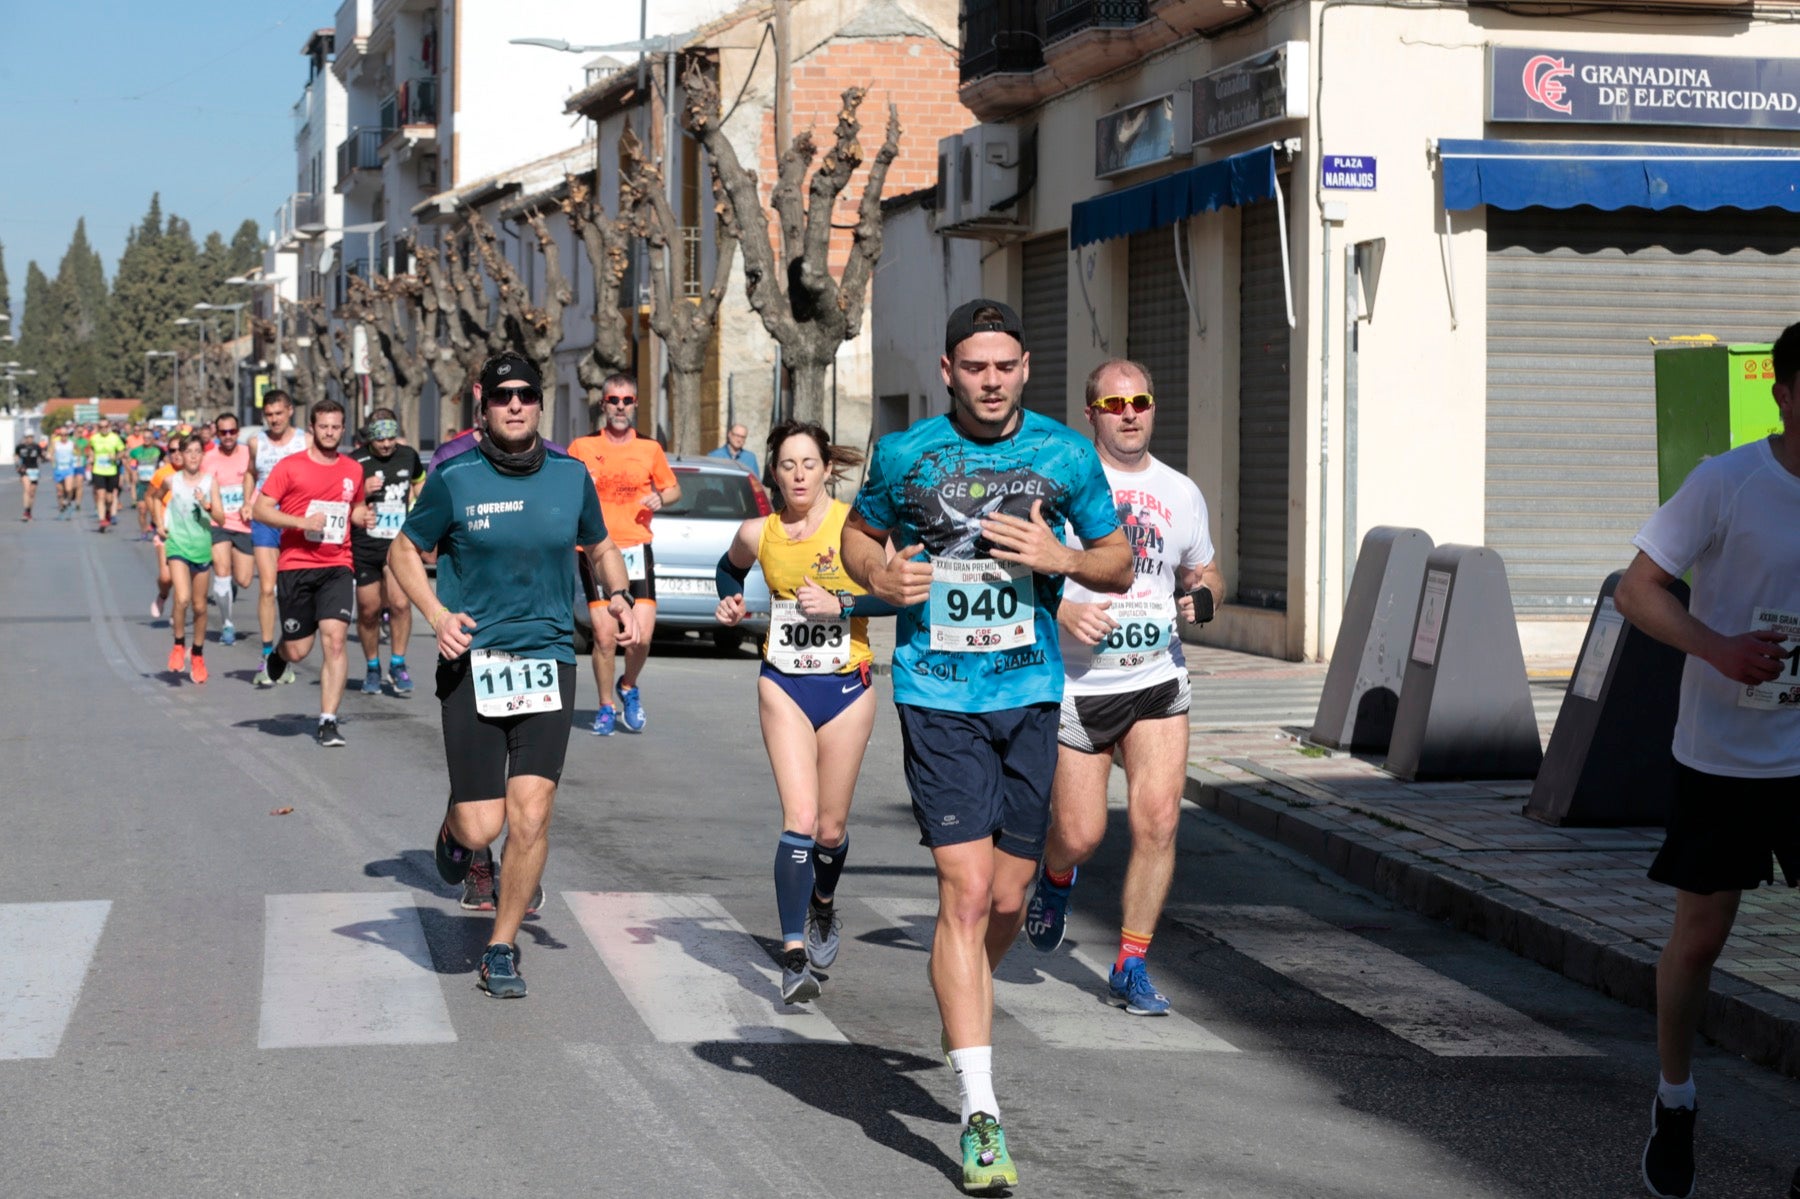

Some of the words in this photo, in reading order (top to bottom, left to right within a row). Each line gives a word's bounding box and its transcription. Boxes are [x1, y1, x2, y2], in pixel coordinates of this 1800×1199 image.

[1580, 65, 1712, 88] GRANADINA
[1598, 87, 1629, 106] DE
[1333, 157, 1363, 168] PLAZA
[1325, 171, 1374, 187] NARANJOS
[465, 506, 475, 517] TE
[477, 500, 524, 514] QUEREMOS
[468, 517, 490, 531] PAPÁ
[953, 562, 970, 571] GRAN
[972, 562, 996, 571] PREMIO
[947, 586, 1018, 622] 940
[1779, 615, 1798, 625] GRAN
[779, 623, 843, 648] 3063
[480, 662, 554, 694] 1113
[913, 660, 968, 682] SOL
